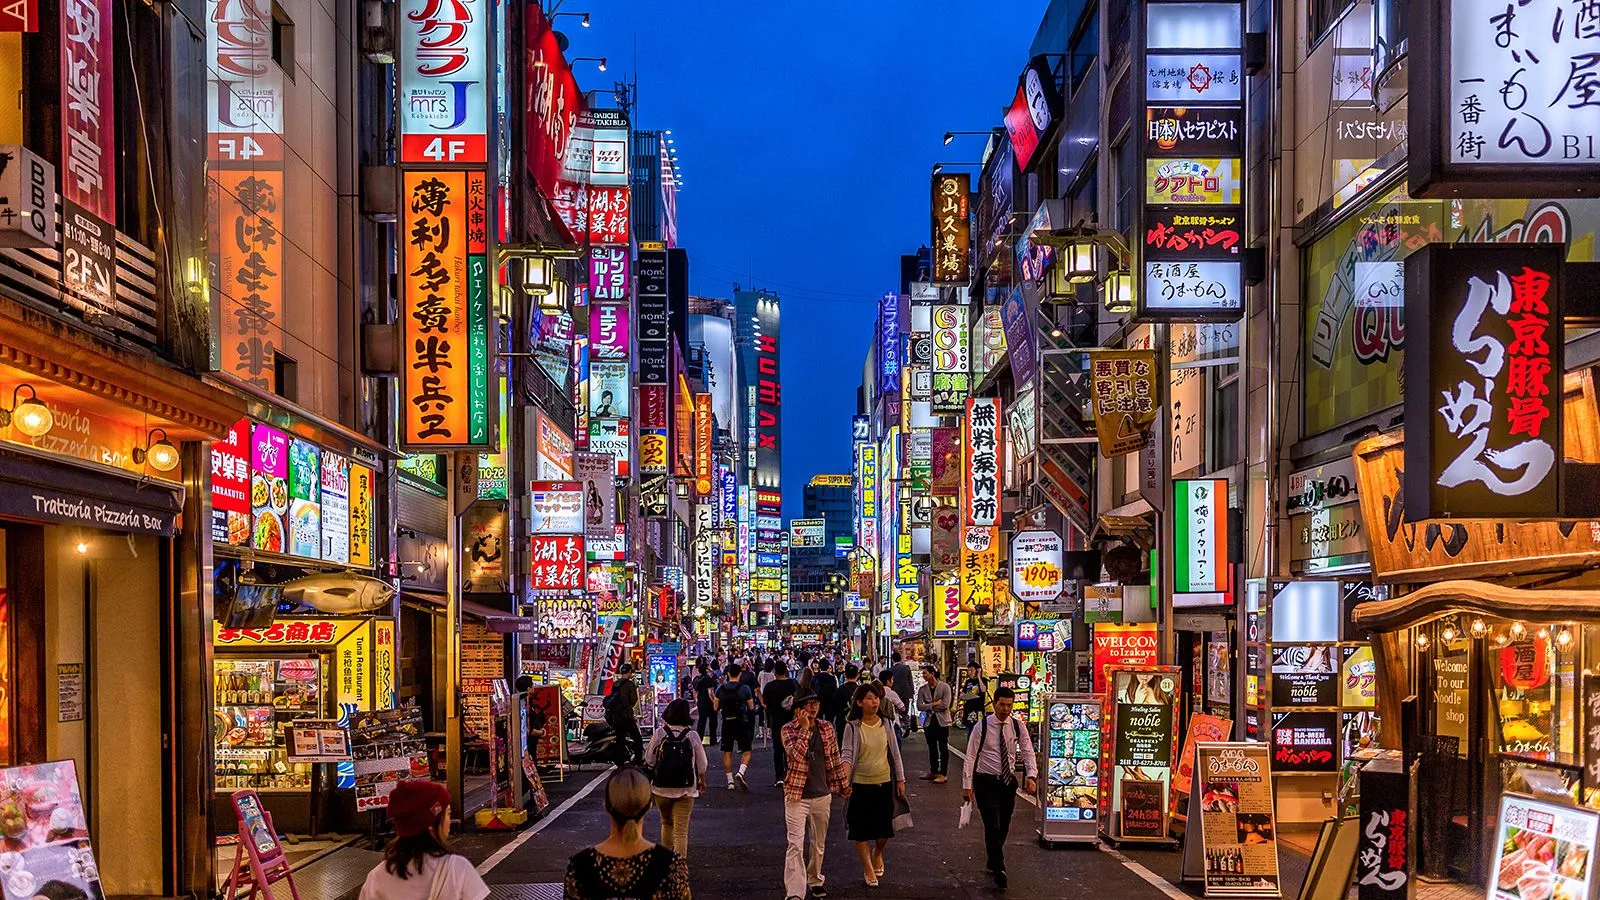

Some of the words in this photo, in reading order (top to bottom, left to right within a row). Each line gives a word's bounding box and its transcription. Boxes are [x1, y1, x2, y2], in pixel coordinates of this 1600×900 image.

[1213, 69, 1239, 86] 桜島
[1490, 0, 1552, 158] まいもん
[429, 81, 479, 130] J
[594, 112, 619, 120] DAIICHI
[1456, 77, 1487, 160] 一番街
[1149, 120, 1238, 141] 日本人セラピスト
[423, 137, 465, 161] 4F
[1154, 176, 1219, 193] クアトロ
[31, 160, 46, 238] BBQ
[590, 190, 628, 213] 湖南
[468, 179, 485, 244] 炭火串焼
[1172, 215, 1236, 226] 東京豚骨ラーメン
[1146, 222, 1240, 251] ばんから
[66, 248, 92, 285] 2F
[611, 248, 625, 299] レンタル
[1148, 263, 1200, 279] 居酒屋
[594, 261, 609, 299] ルーム
[1212, 299, 1238, 308] 一番街
[600, 306, 617, 344] エデン
[884, 291, 899, 390] カラオケの鉄人
[1507, 266, 1552, 438] 東京豚骨
[1095, 359, 1149, 377] 悪質な
[759, 334, 781, 449] HUMAX
[933, 372, 969, 391] 麻雀
[1096, 379, 1150, 397] 客引き
[1437, 270, 1556, 496] らーめん
[948, 391, 967, 405] 4F
[1099, 397, 1152, 415] に注意
[1185, 413, 1197, 435] 2F
[591, 440, 628, 449] XROSS
[971, 403, 997, 520] 無料案内所
[828, 476, 842, 484] SUPER
[212, 484, 245, 500] ANRAKUTEI
[725, 475, 736, 513] カラオケ
[32, 494, 91, 520] Trattoria
[94, 505, 140, 528] Pizzeria
[143, 514, 163, 530] Bar
[534, 537, 582, 563] 湖南
[966, 532, 990, 546] 新宿
[1193, 505, 1209, 580] 俺のイタリアン
[965, 553, 982, 605] まっちゃん
[1025, 566, 1059, 582] 190円
[945, 586, 960, 630] クラウン
[356, 636, 364, 656] Tuna
[1019, 622, 1055, 650] 麻雀
[1110, 649, 1119, 657] to
[1120, 648, 1156, 659] Izakaya
[1433, 658, 1467, 674] Welcome
[356, 657, 364, 702] Restaurant
[1437, 675, 1450, 688] To
[1450, 678, 1465, 689] our
[1290, 686, 1318, 697] noble
[1433, 690, 1462, 705] Noodle
[1130, 714, 1161, 727] noble
[1445, 709, 1465, 724] shop
